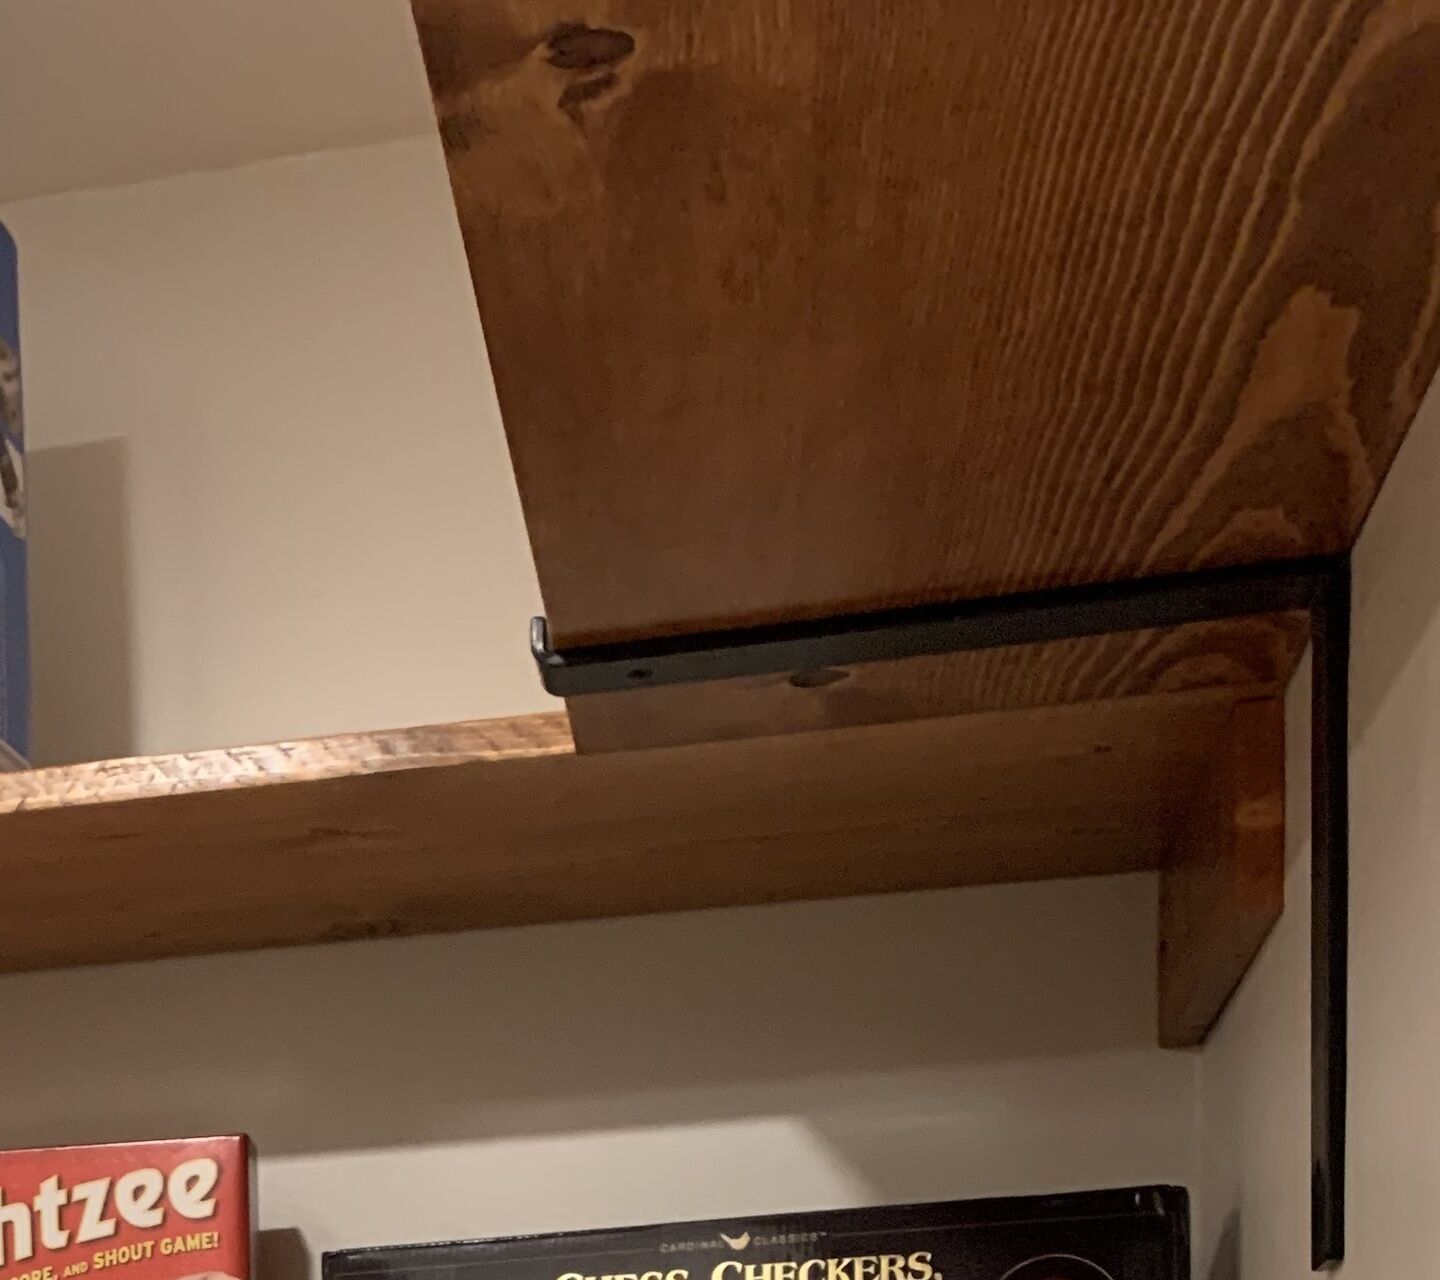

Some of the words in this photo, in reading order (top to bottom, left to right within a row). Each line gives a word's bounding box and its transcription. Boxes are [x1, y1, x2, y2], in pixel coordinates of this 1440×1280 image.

[63, 1261, 89, 1278] AND
[92, 1240, 154, 1272] SHOUT
[160, 1231, 219, 1256] GAME!
